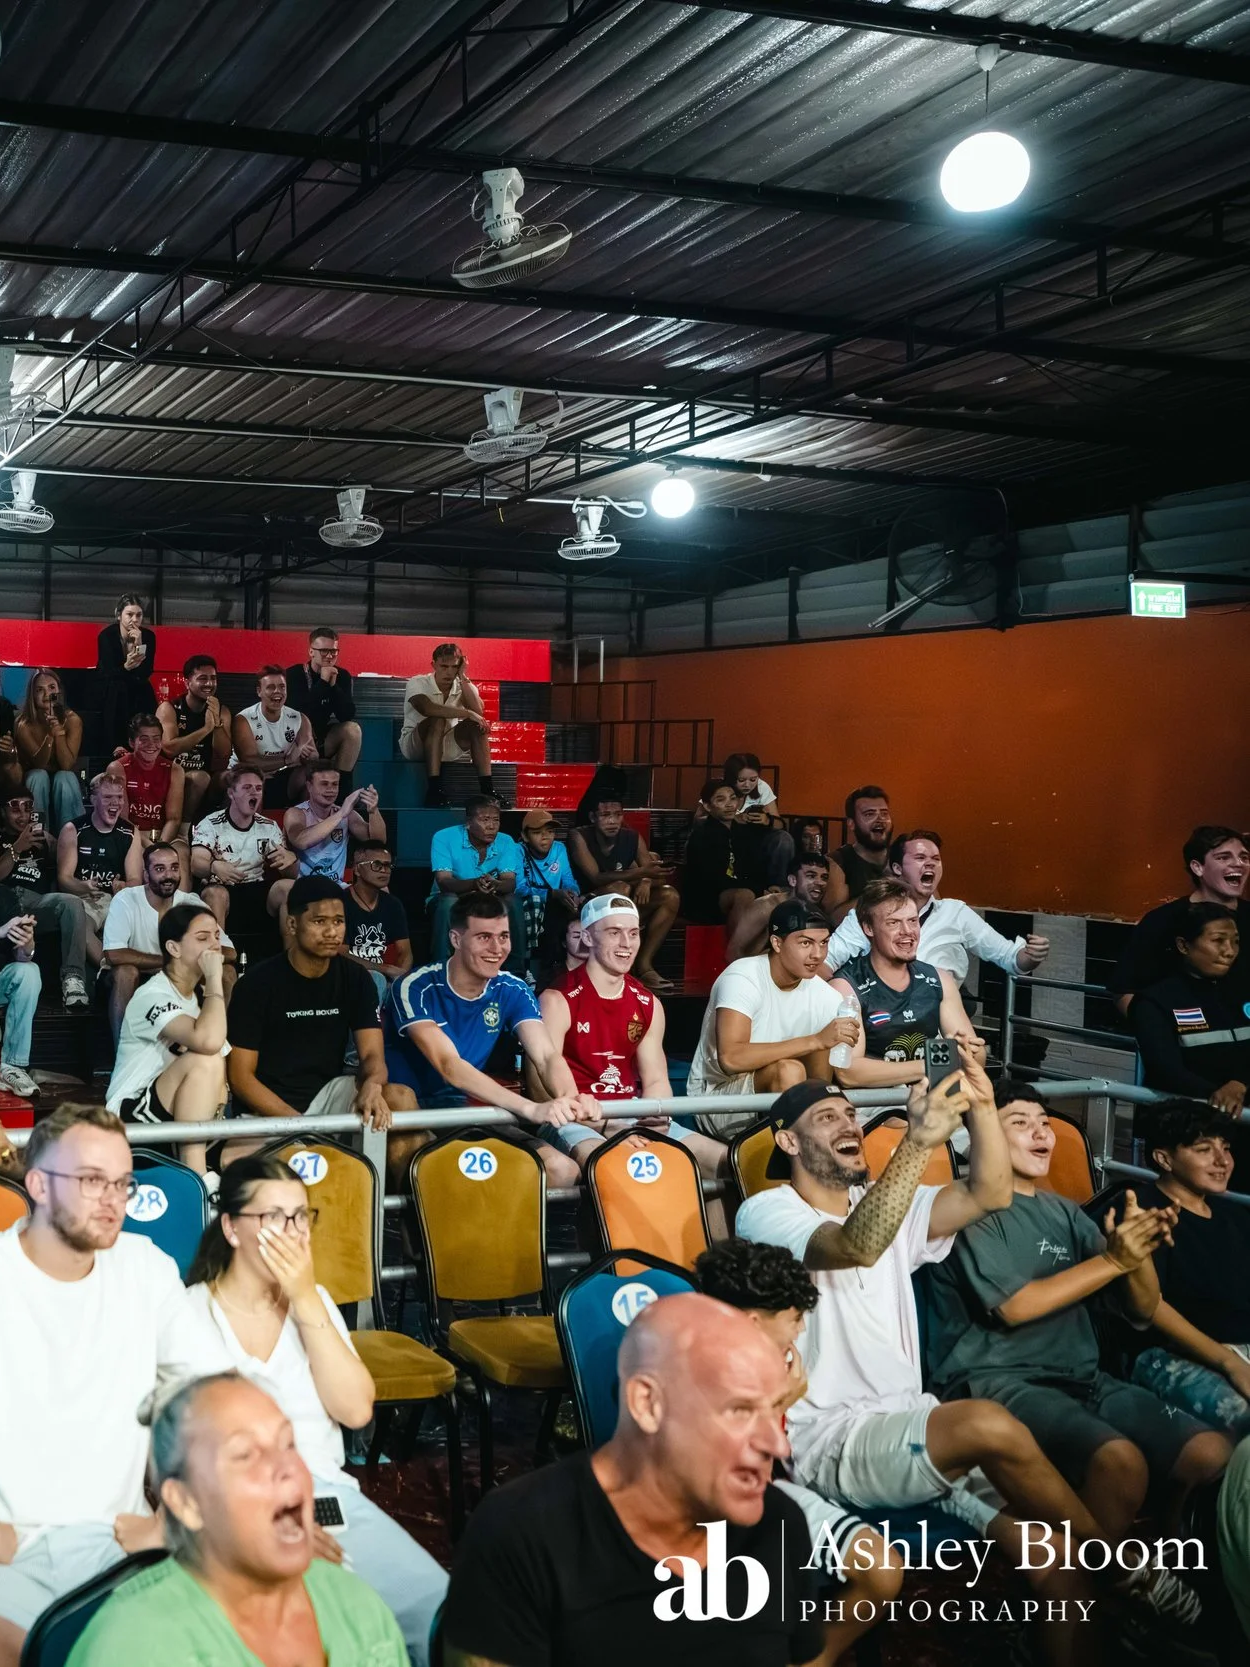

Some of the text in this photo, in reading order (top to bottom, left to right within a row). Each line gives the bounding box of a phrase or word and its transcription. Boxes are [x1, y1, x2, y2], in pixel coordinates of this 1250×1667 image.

[293, 1154, 320, 1179] 27
[465, 1152, 492, 1174] 26
[631, 1156, 658, 1178] 25
[134, 1190, 163, 1213] 28
